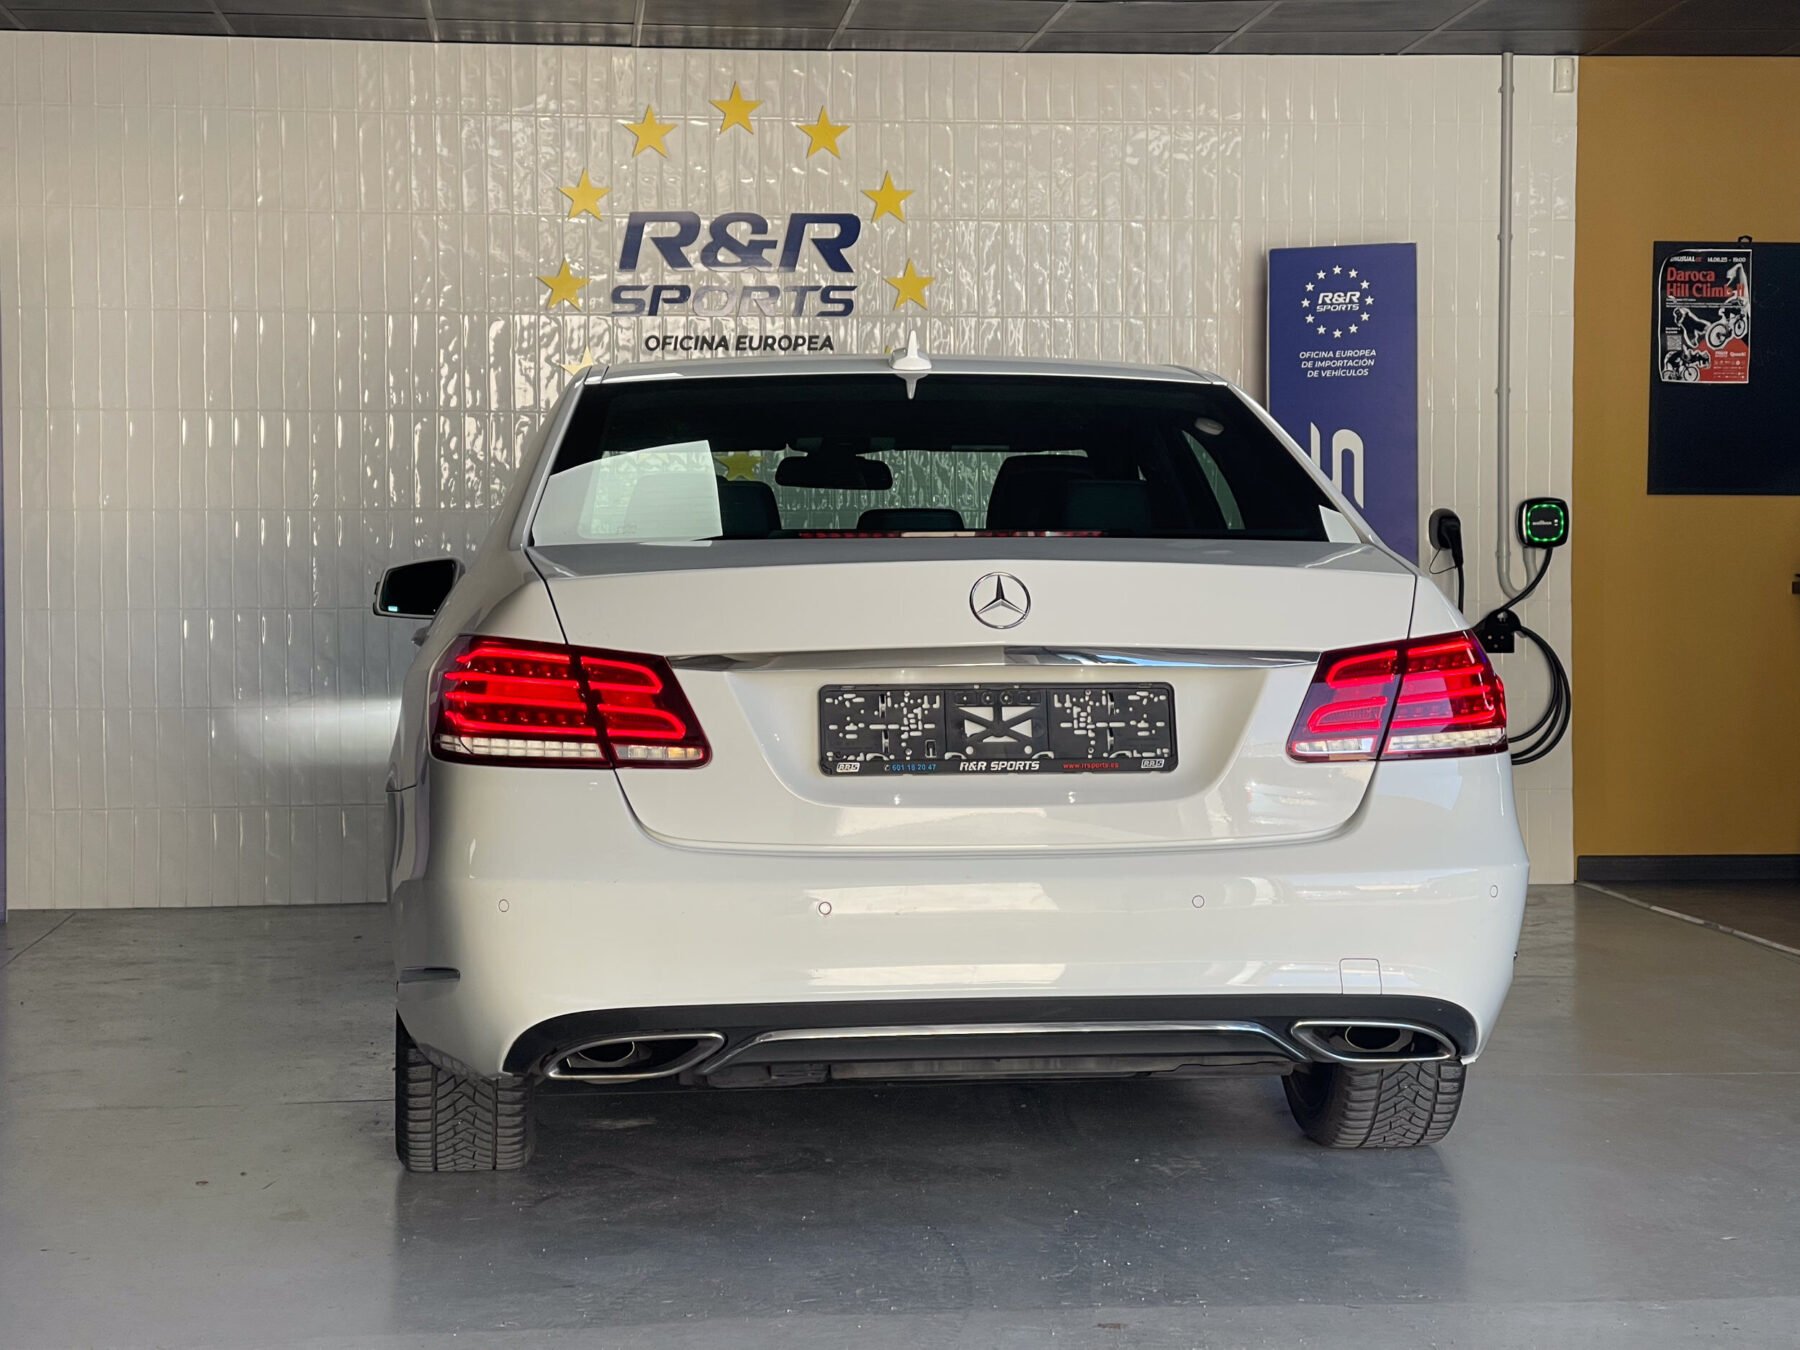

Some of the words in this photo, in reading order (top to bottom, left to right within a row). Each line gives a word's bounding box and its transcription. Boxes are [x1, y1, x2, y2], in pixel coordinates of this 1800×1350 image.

[617, 211, 861, 273] R&R
[1666, 267, 1715, 281] Daroca
[1666, 283, 1689, 297] Hill
[1692, 283, 1733, 297] Climb
[610, 284, 858, 317] SPORTS
[1318, 291, 1360, 304] R&R
[1316, 303, 1360, 312] SPORTS
[645, 335, 729, 352] OFICINA
[736, 334, 834, 352] EUROPEA
[1299, 350, 1334, 359] OFICINA
[1335, 349, 1376, 358] EUROPEA
[1301, 360, 1313, 369] DE
[1315, 357, 1375, 368] IMPORTACIÓN
[1307, 370, 1319, 378] DE
[1321, 368, 1369, 377] VEHÍCULOS
[959, 761, 987, 771] R&R
[990, 760, 1040, 771] SPORTS
